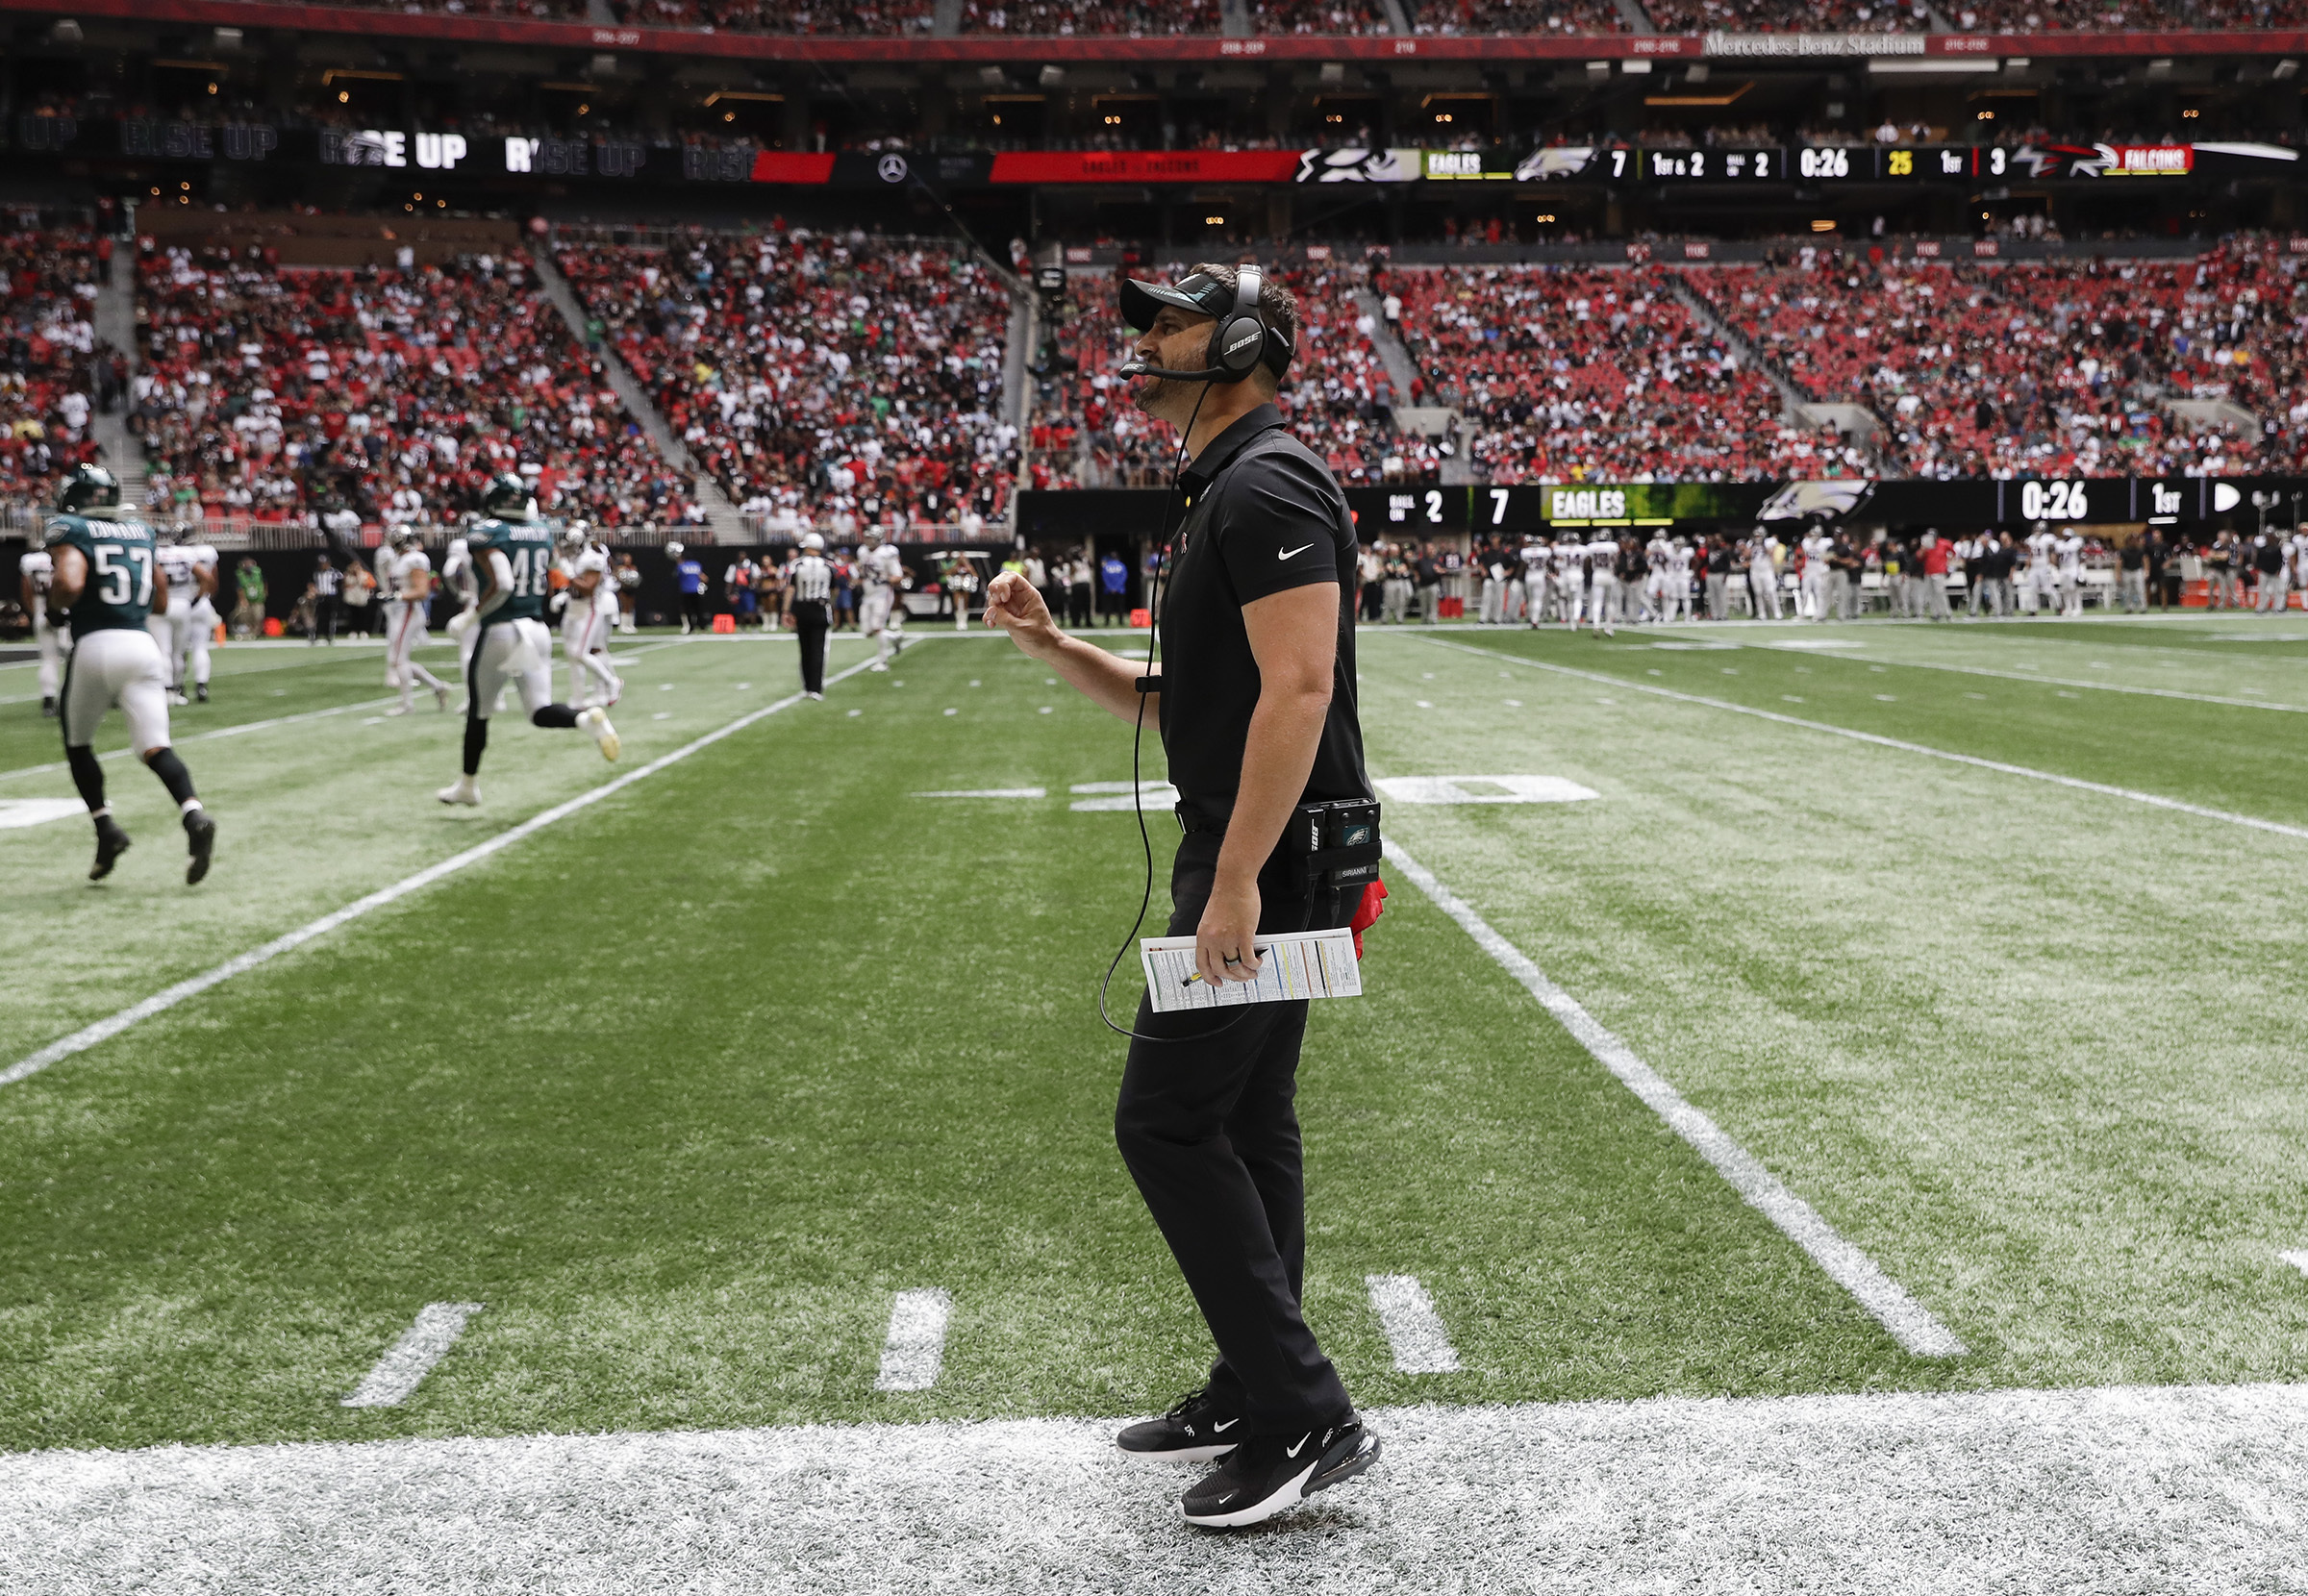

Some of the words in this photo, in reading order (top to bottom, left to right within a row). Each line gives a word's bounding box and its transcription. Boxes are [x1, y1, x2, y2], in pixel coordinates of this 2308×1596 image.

[1706, 33, 1843, 56] Mercedes-Benz
[1847, 34, 1924, 55] Stadium
[222, 123, 278, 161] UP
[414, 132, 467, 169] UP
[596, 142, 645, 177] UP
[1428, 153, 1481, 174] EAGLES
[1612, 150, 1626, 177] 7
[1675, 159, 1686, 175] &
[1691, 151, 1704, 176] 2
[1755, 151, 1769, 177] 2
[1800, 148, 1848, 177] 0:26
[1889, 150, 1913, 175] 25
[1990, 147, 2006, 175] 3
[2124, 149, 2186, 170] FALCONS
[1223, 331, 1262, 356] BOSE
[1389, 494, 1416, 510] BALL
[1424, 489, 1442, 523] 2
[1490, 488, 1509, 525] 7
[1552, 490, 1625, 519] EAGLES
[2021, 480, 2088, 520] 0:26
[2151, 482, 2182, 514] 1ST
[1389, 508, 1405, 521] ON
[94, 544, 153, 606] 57
[513, 548, 549, 597] 48
[1342, 865, 1368, 878] SIRIANNI
